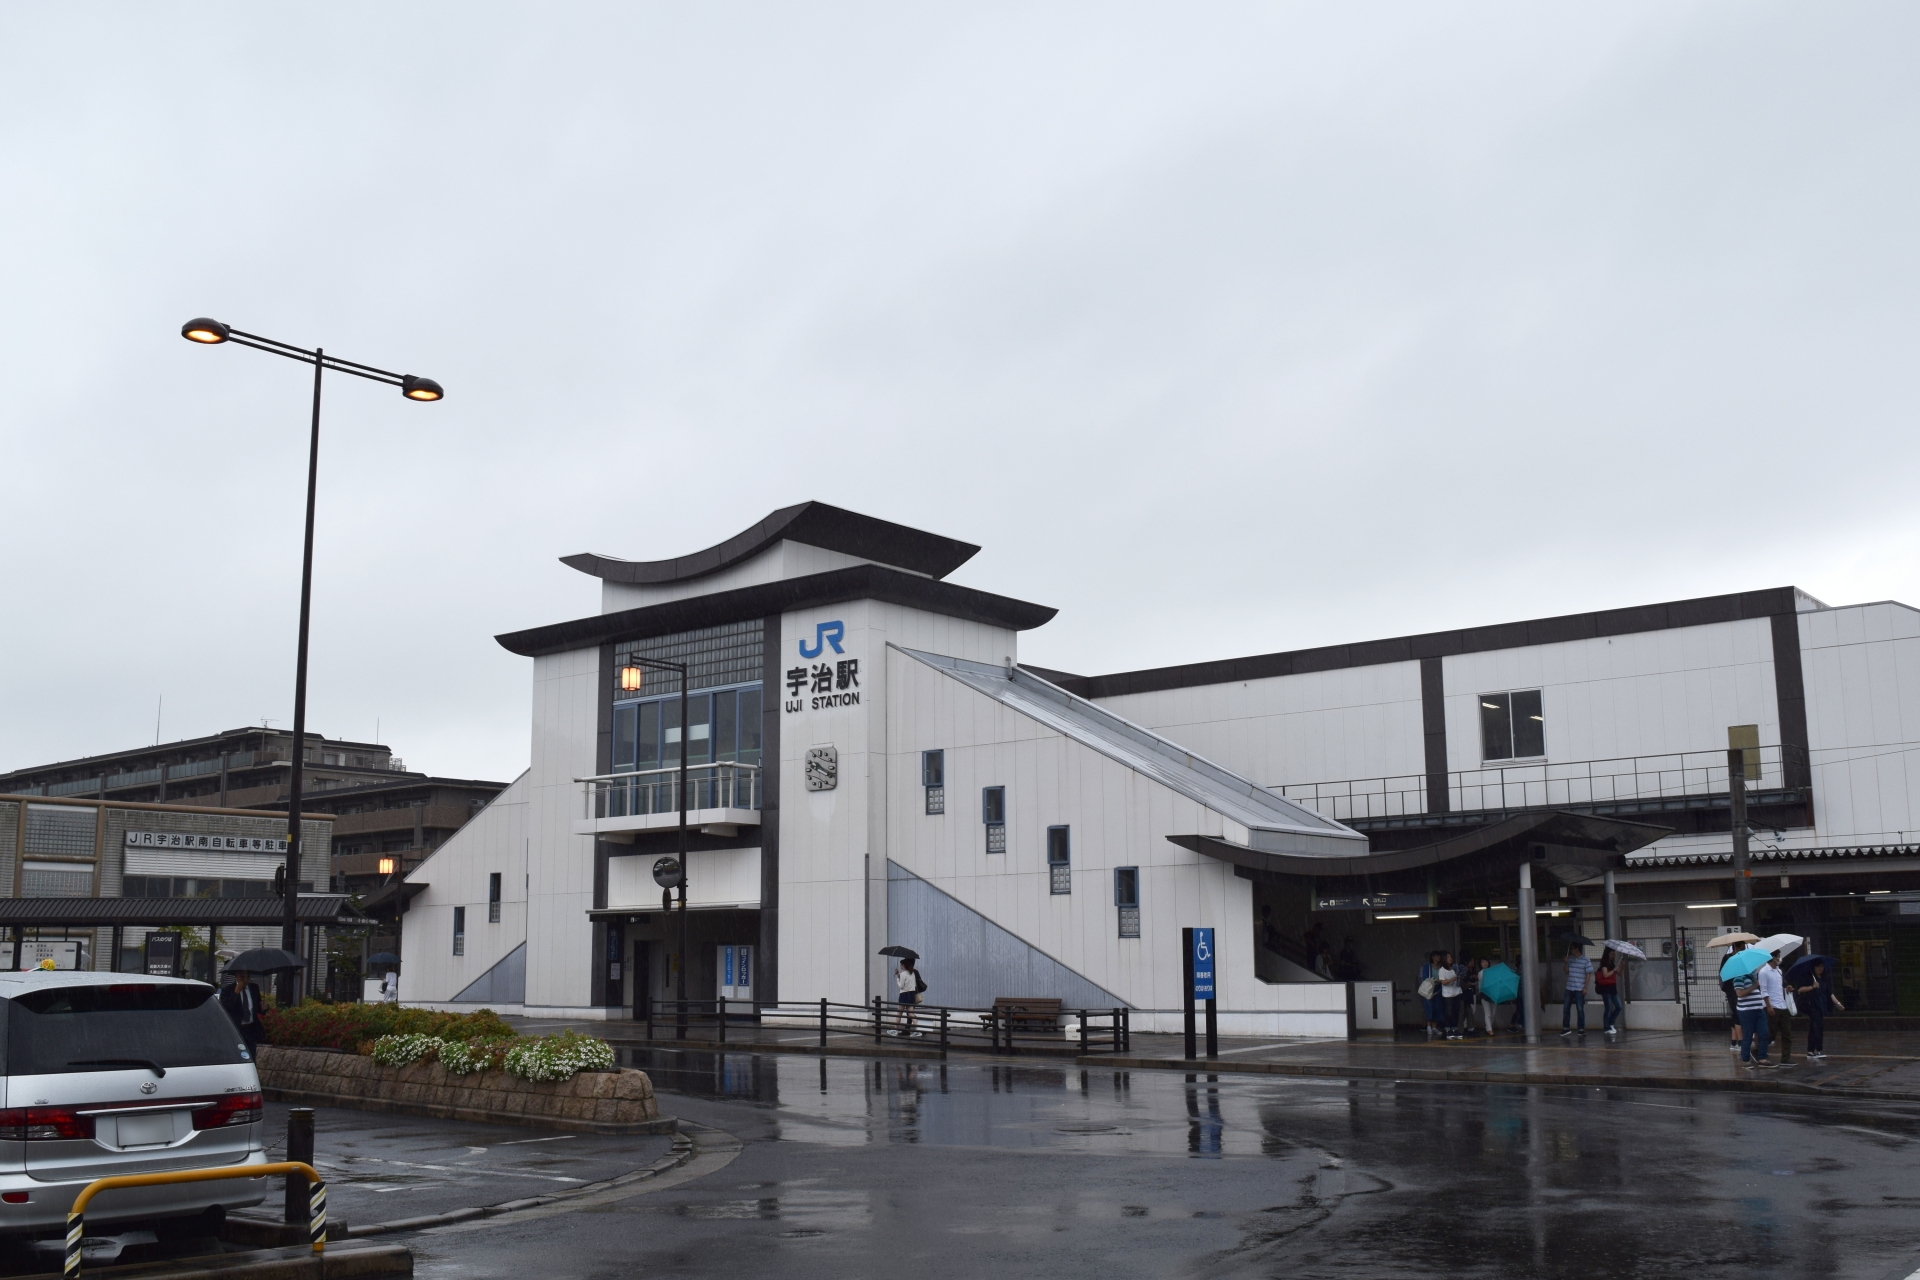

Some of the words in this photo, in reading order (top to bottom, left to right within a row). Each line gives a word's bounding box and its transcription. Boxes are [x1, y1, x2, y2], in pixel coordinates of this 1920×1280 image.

[799, 620, 845, 659] JR
[786, 658, 860, 697] 宇治駅
[786, 699, 803, 714] UJI
[811, 691, 861, 710] STATION
[129, 833, 289, 851] JR宇治駅南自転車等駐車
